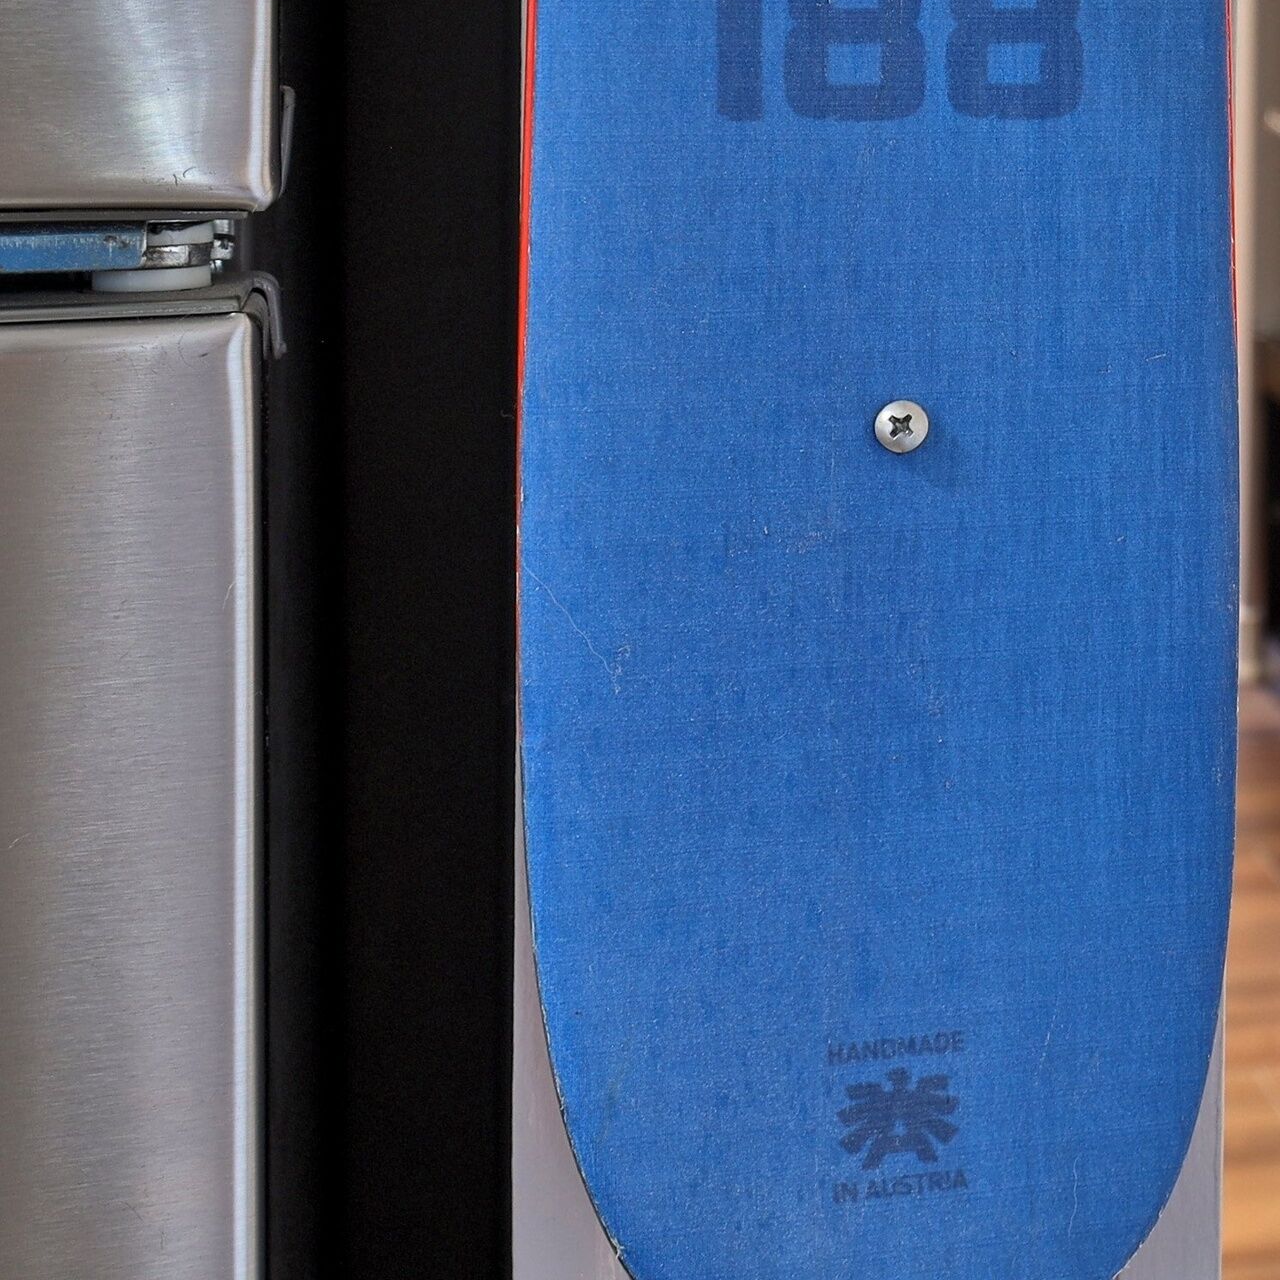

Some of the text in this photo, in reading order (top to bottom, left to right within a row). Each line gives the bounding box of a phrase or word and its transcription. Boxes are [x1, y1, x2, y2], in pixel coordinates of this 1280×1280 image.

[827, 1030, 965, 1066] HANDMADE
[832, 1168, 969, 1206] IN AUSTRIA
